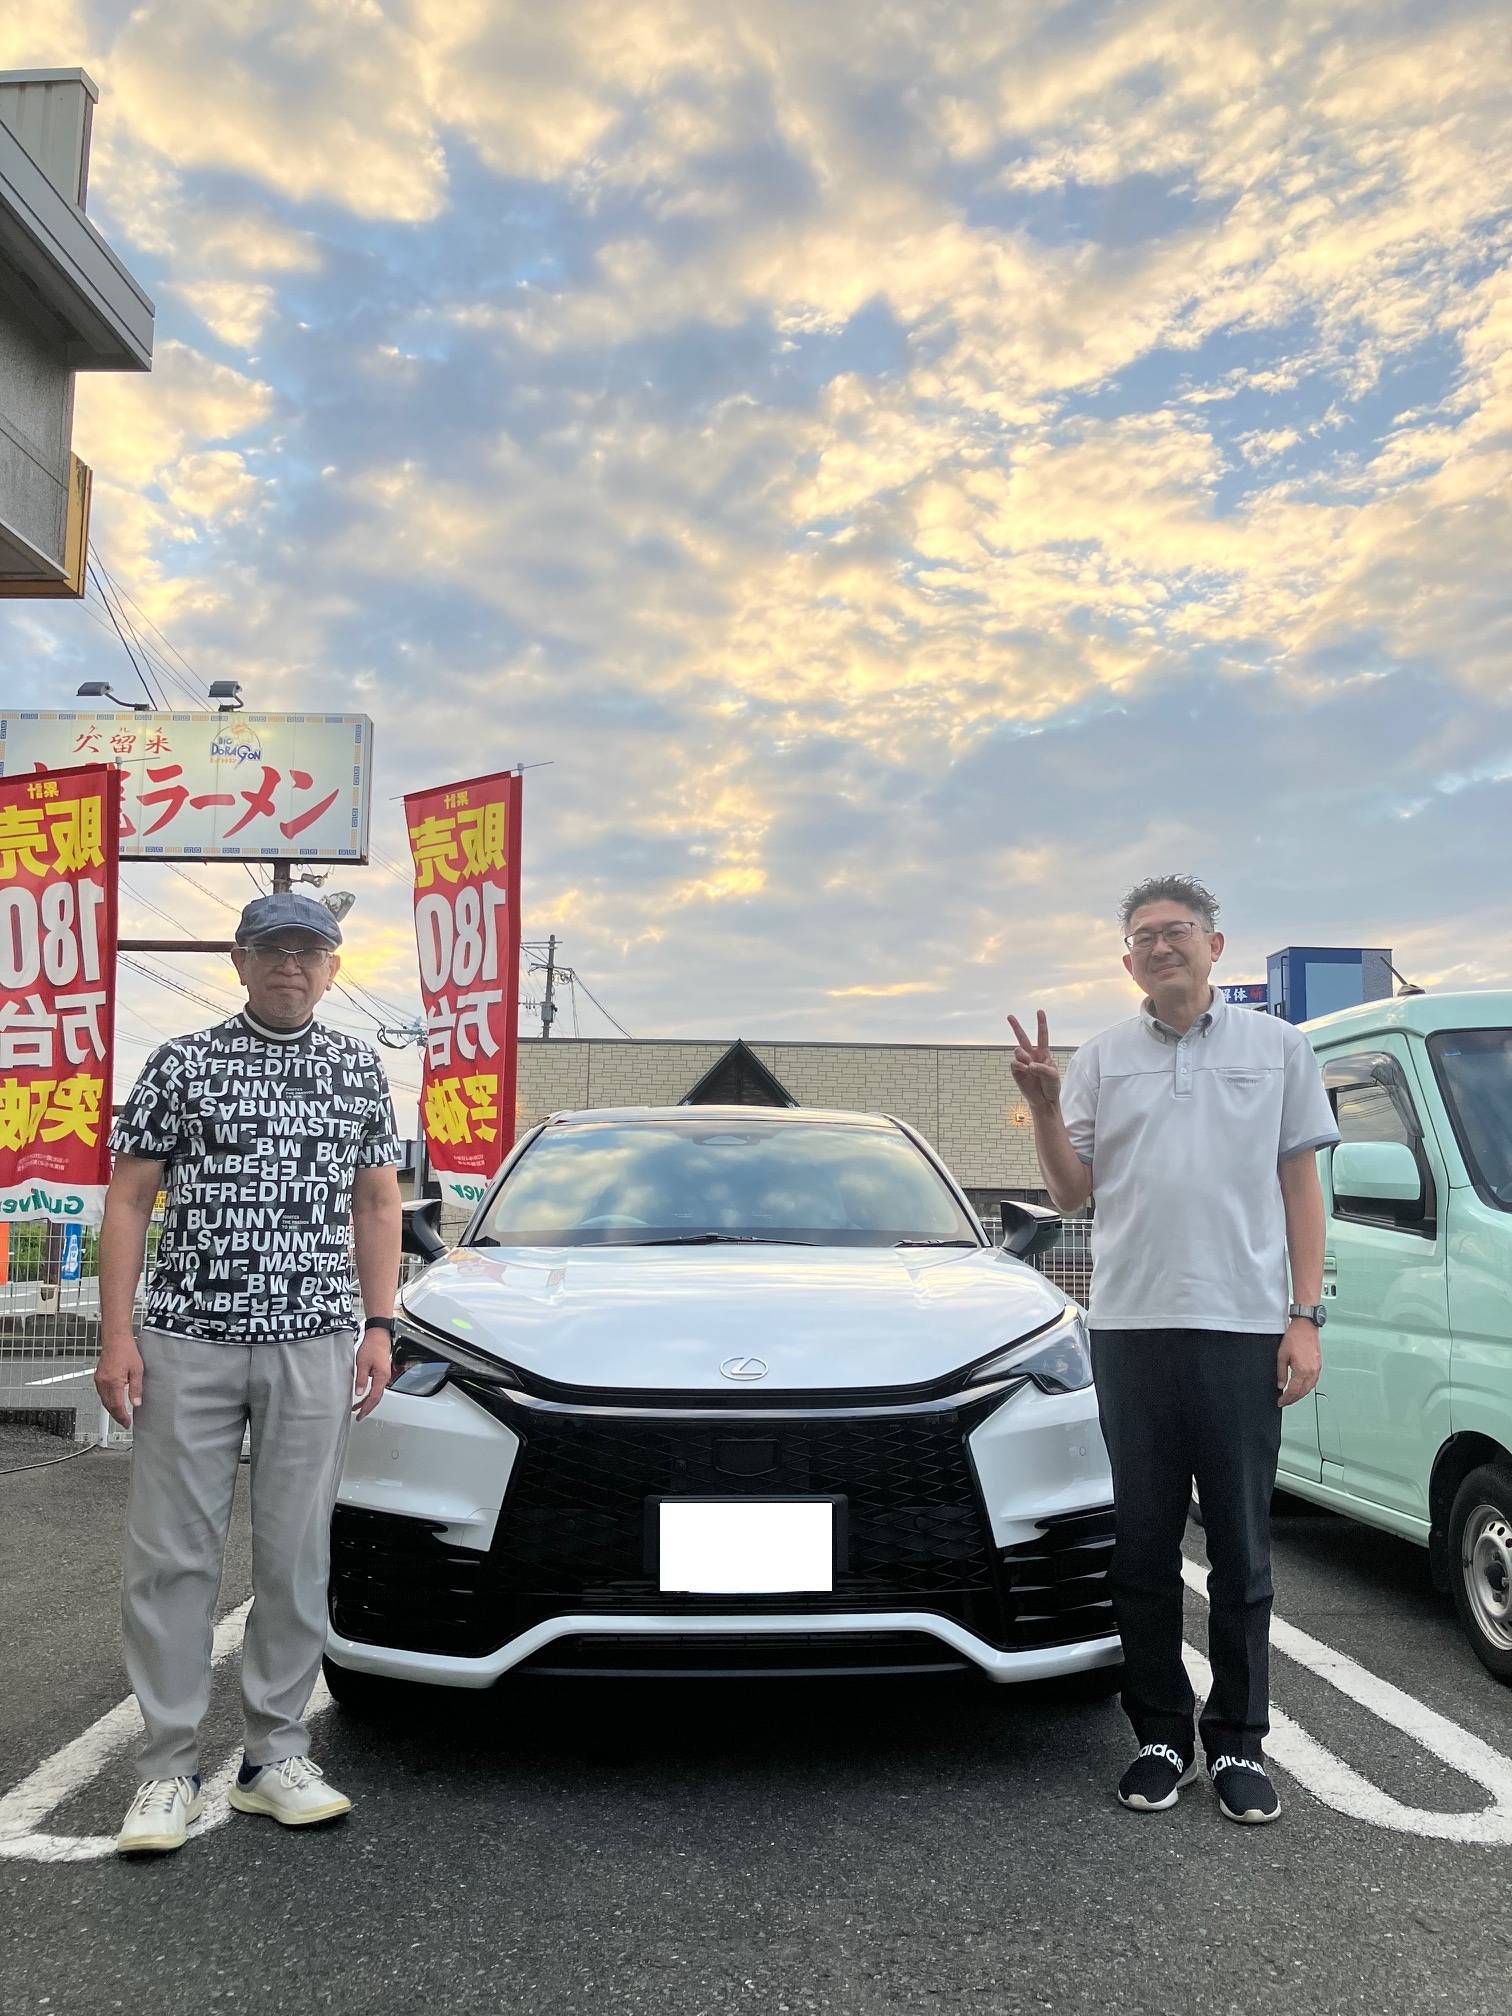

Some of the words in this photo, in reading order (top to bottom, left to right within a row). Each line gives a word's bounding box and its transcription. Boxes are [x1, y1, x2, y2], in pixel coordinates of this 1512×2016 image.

[73, 731, 172, 755] 久留米
[118, 762, 340, 841] ラーメン
[187, 1079, 288, 1100] BUNNY
[187, 1207, 286, 1230] BUNNY
